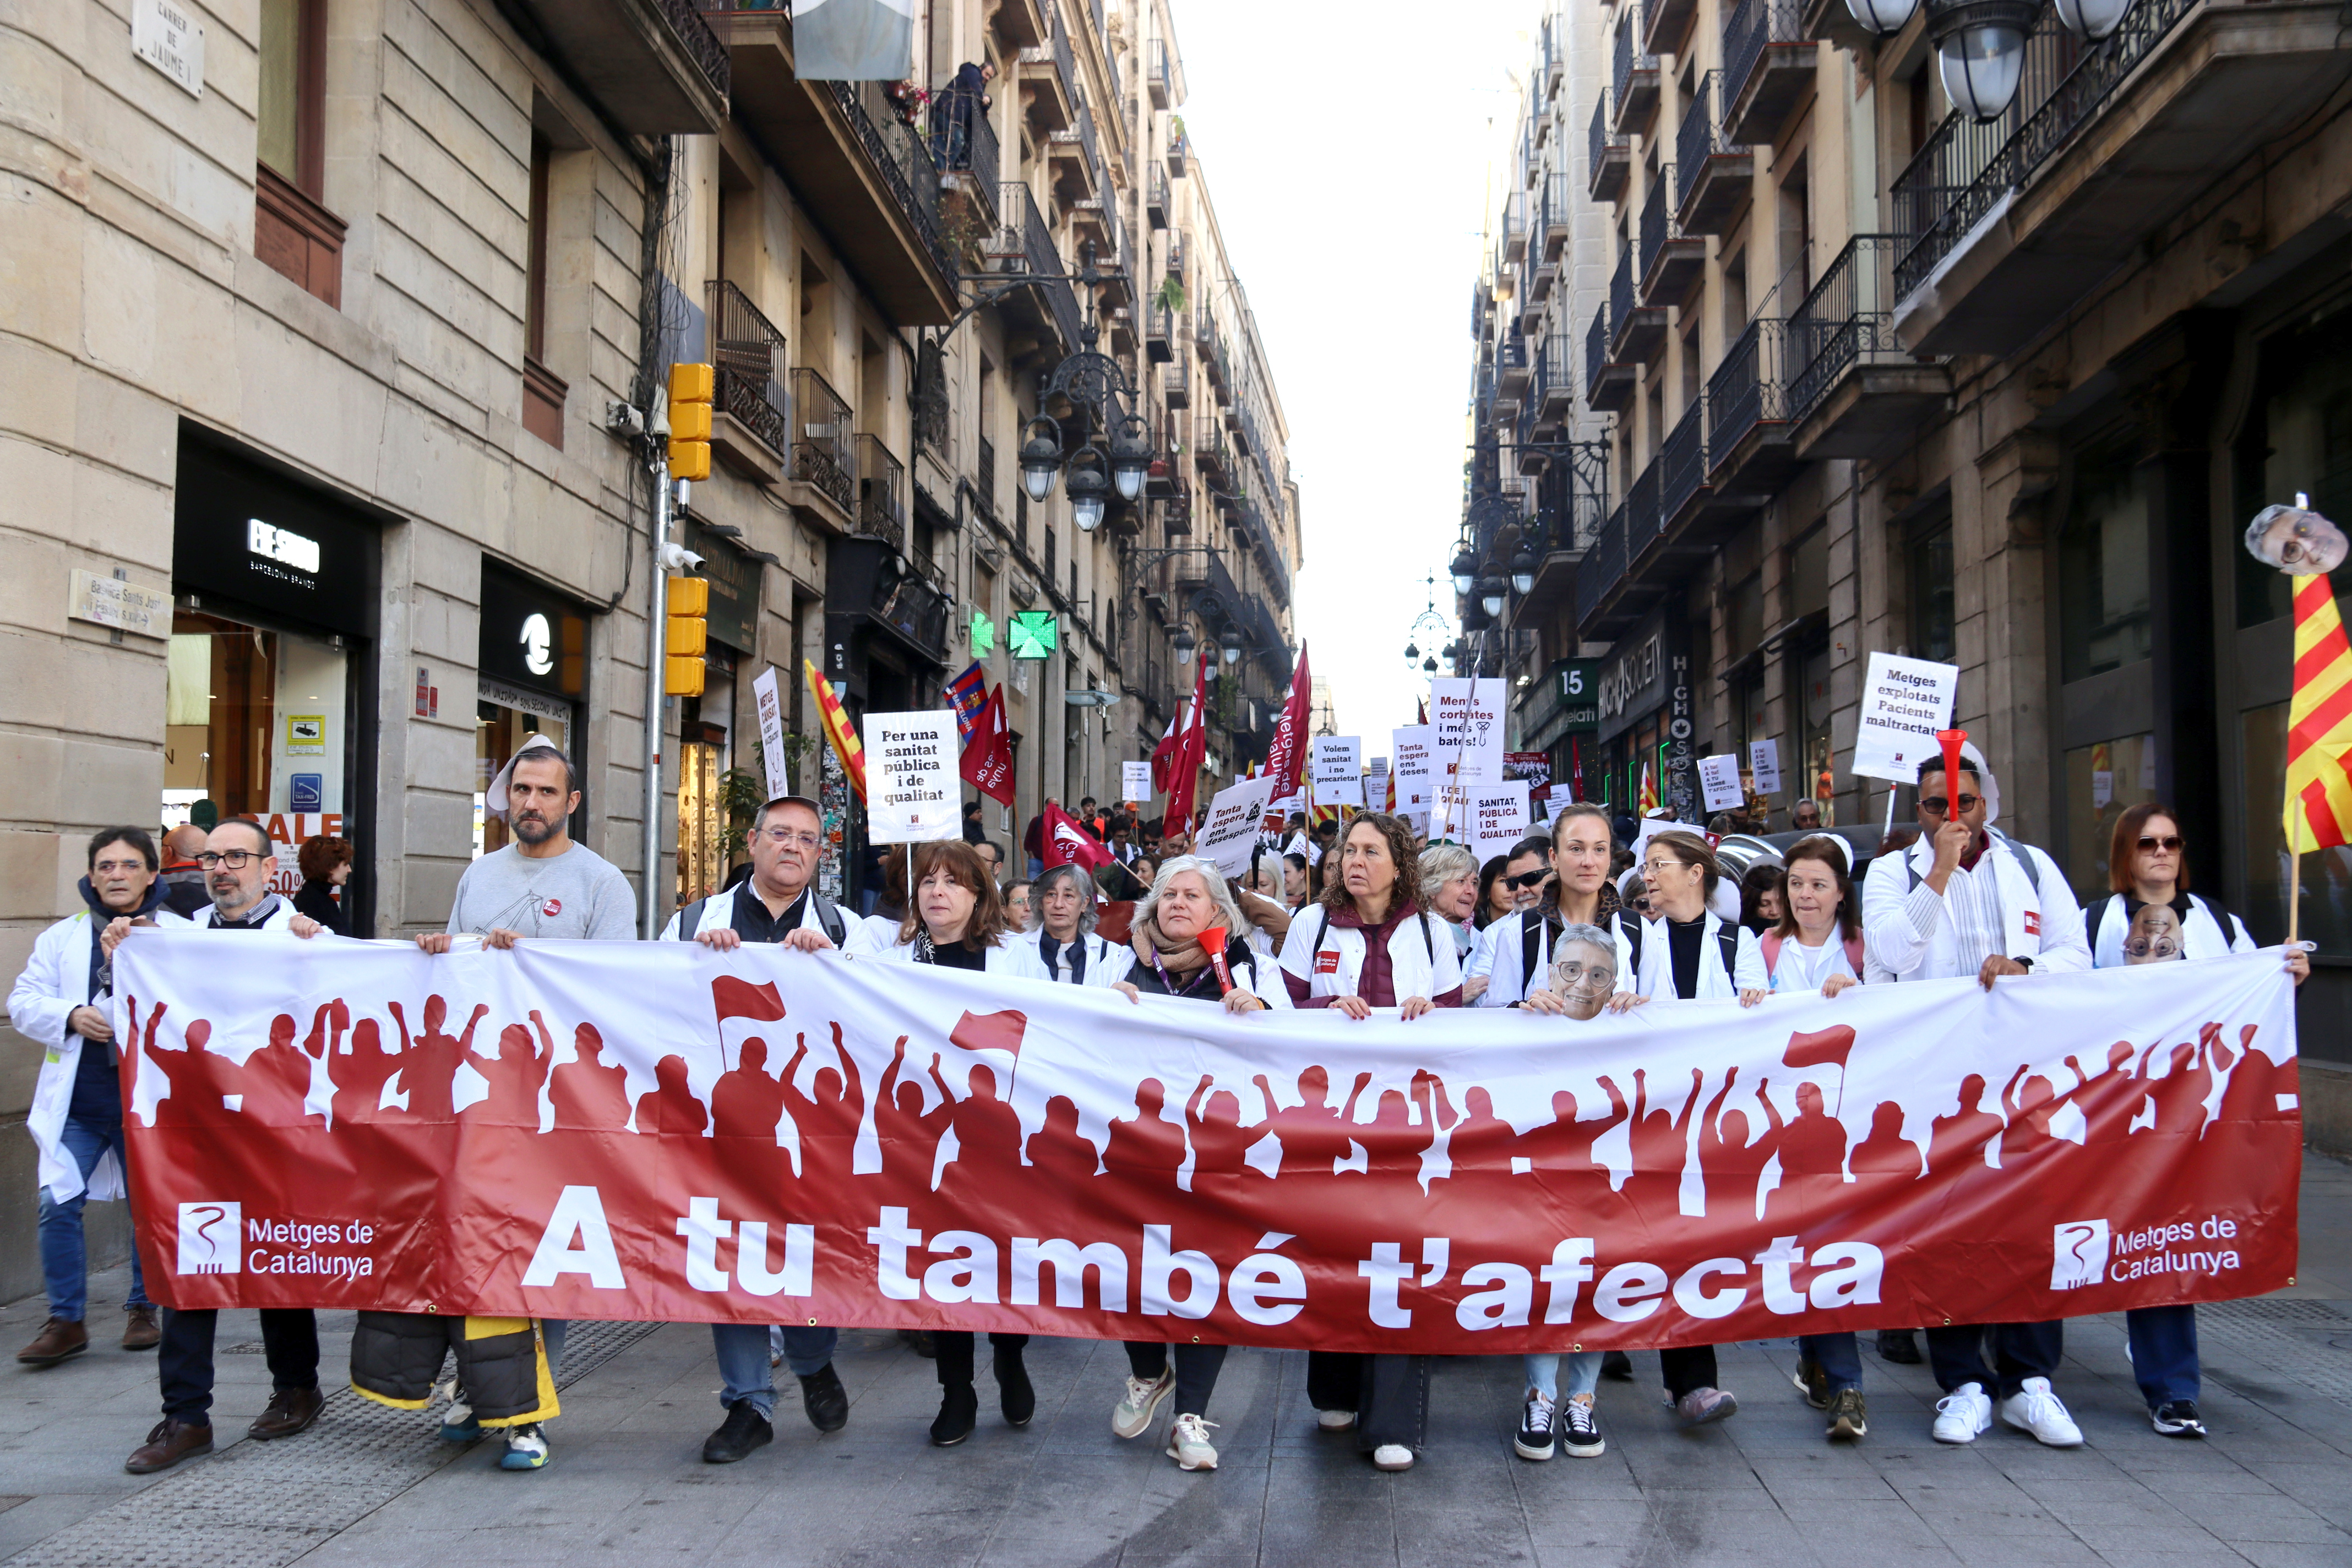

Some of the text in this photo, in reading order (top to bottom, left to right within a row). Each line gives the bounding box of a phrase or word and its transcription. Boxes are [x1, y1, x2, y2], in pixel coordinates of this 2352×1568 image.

[157, 2, 188, 34] CARRER
[167, 30, 177, 48] DE
[151, 41, 191, 84] JAUME I
[251, 560, 315, 591] BARCELONA BRANDS
[123, 589, 143, 606] Sants
[145, 595, 161, 610] Just
[1625, 632, 1662, 700] SOCIETY
[1561, 670, 1583, 695] 15
[1673, 656, 1687, 715] HIGH
[1886, 669, 1937, 688] Metges
[760, 689, 774, 710] METGE
[1877, 686, 1941, 705] explotats
[531, 698, 550, 715] SECOND
[552, 706, 566, 718] UNIT
[952, 694, 973, 732] BARCELONA
[1565, 707, 1595, 723] elati
[1877, 700, 1936, 720] Pacients
[881, 730, 939, 742] Per una
[1439, 723, 1472, 733] i més
[885, 744, 937, 757] sanitat
[1279, 706, 1294, 793] Metges de
[1399, 752, 1429, 760] espera
[884, 759, 940, 775] pública
[1322, 755, 1351, 764] sanitat
[897, 774, 924, 787] i de
[1316, 775, 1358, 785] precarietat
[1529, 773, 1550, 791] AGA
[1708, 784, 1735, 793] T'AFECTA!
[884, 790, 944, 807] qualitat
[1447, 786, 1460, 795] DE
[1478, 797, 1517, 808] SANITAT,
[1212, 812, 1245, 829] espera
[1216, 805, 1242, 819] Tanta
[1479, 808, 1518, 818] PÚBLICA
[1209, 827, 1227, 838] ens
[1485, 820, 1498, 828] DE
[1205, 825, 1255, 847] desespera
[1479, 829, 1523, 839] QUALITAT
[249, 1218, 373, 1249] Metges de
[2114, 1214, 2237, 1256] Metges de
[248, 1248, 373, 1282] Catalunya
[520, 1184, 1885, 1331] A tu també t'afecta
[2110, 1249, 2240, 1282] Catalunya
